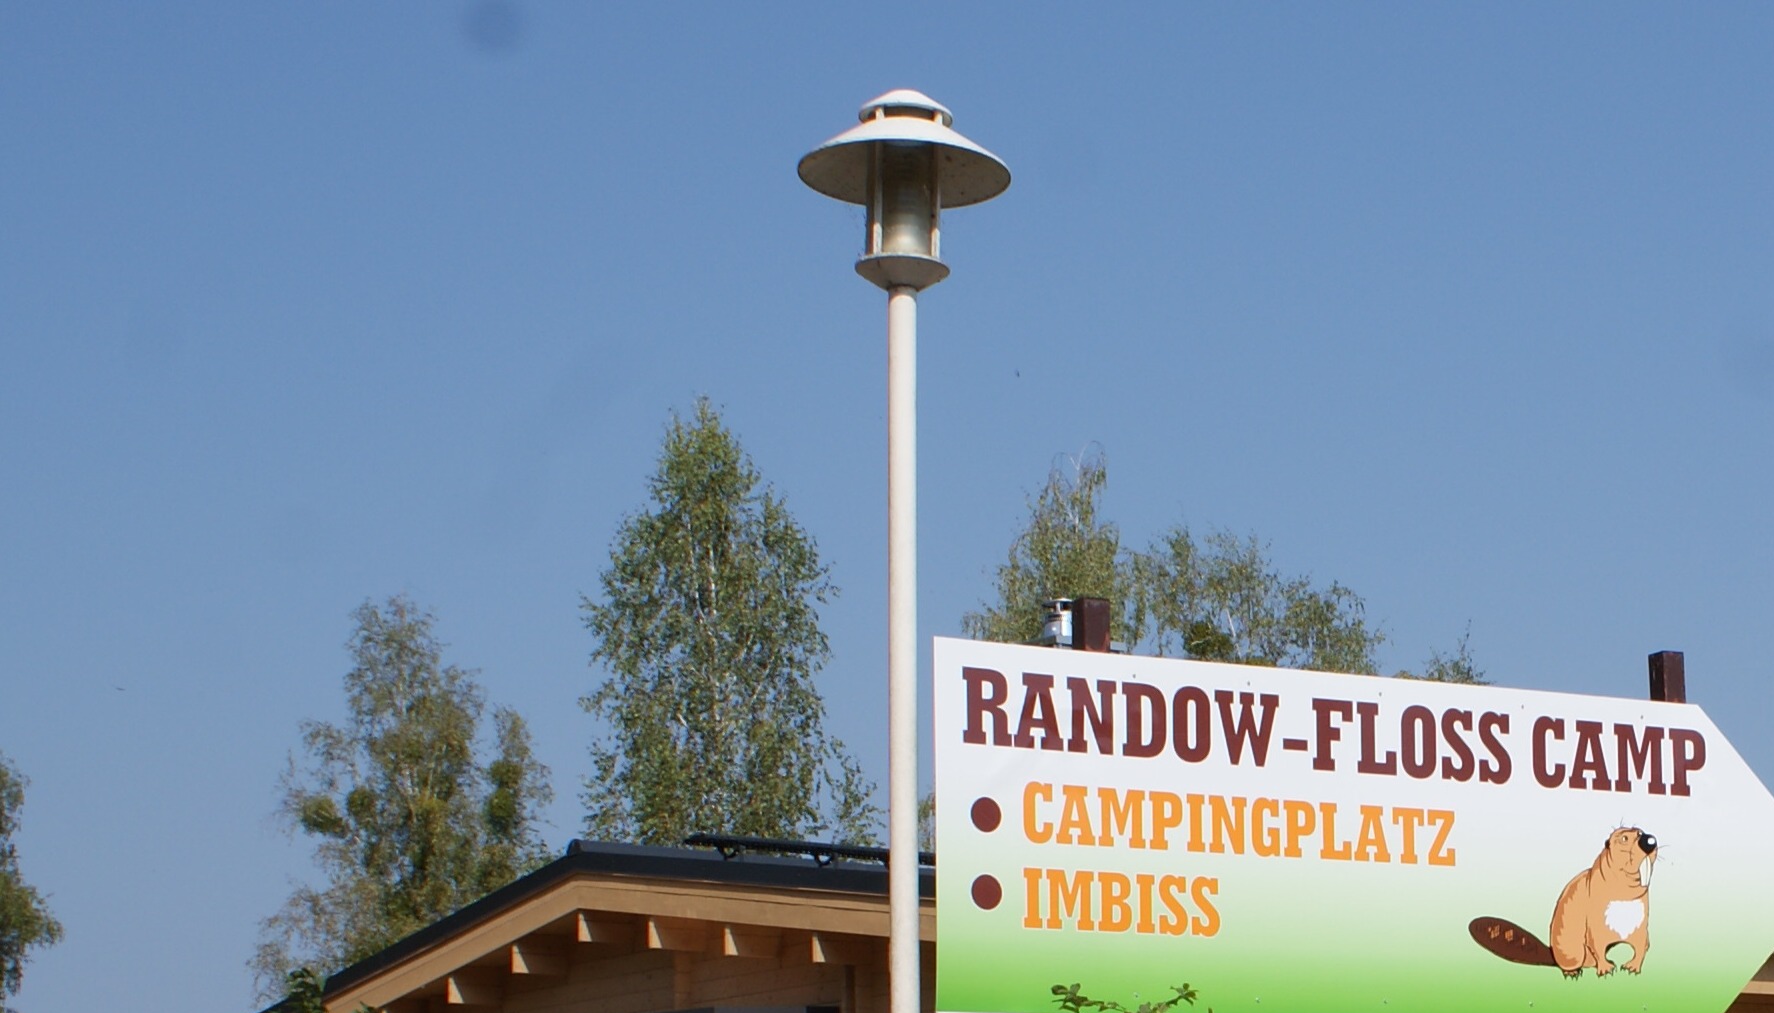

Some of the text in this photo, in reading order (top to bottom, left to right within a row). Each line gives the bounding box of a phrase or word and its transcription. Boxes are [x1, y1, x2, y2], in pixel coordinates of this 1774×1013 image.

[962, 666, 1707, 797] RANDOW-FLOSS CAMP
[1022, 781, 1457, 868] CAMPINGPLATZ
[1022, 867, 1222, 938] IMBISS
